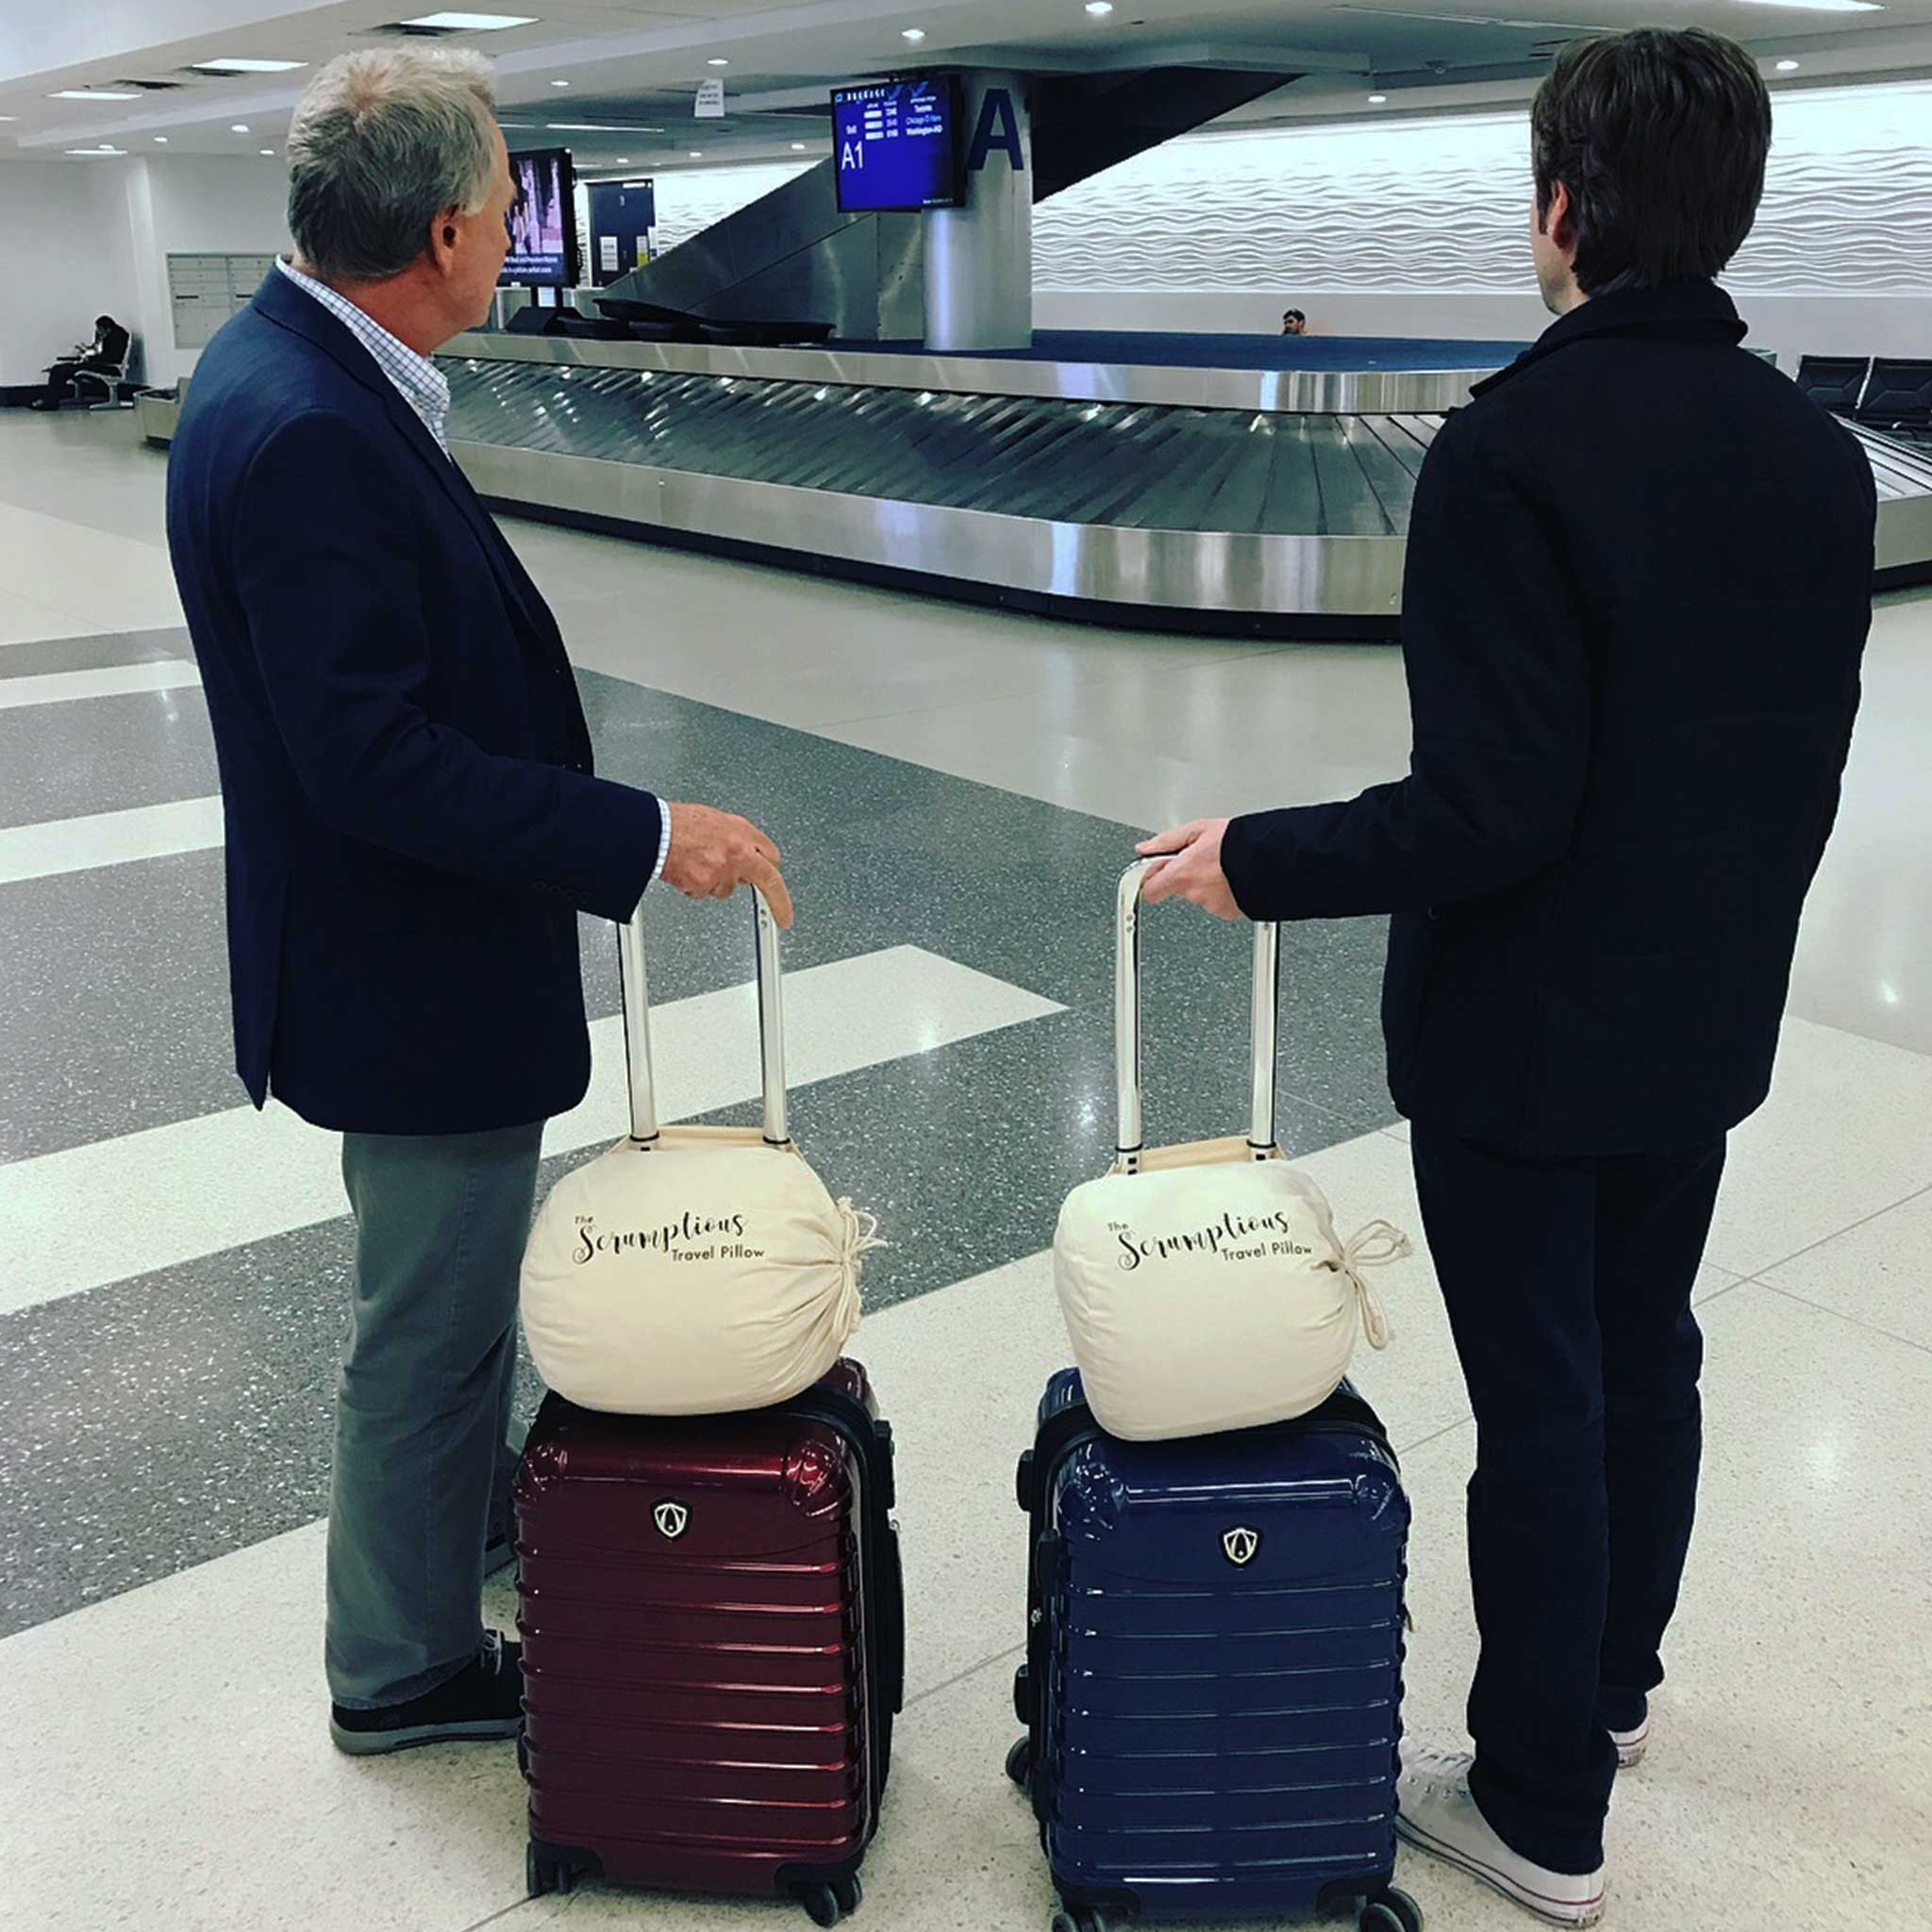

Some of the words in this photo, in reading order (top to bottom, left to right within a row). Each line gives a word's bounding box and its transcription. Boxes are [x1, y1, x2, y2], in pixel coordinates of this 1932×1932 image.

[966, 89, 1024, 171] A
[841, 141, 863, 171] A1
[575, 1215, 594, 1224] The
[1107, 1222, 1130, 1233] The
[572, 1211, 748, 1265] Scrumptious
[1117, 1210, 1290, 1271] Scrumptious
[1222, 1241, 1267, 1262] Travel
[1272, 1240, 1313, 1257] Pillow
[672, 1245, 715, 1262] Travel
[720, 1244, 765, 1259] Pillow
